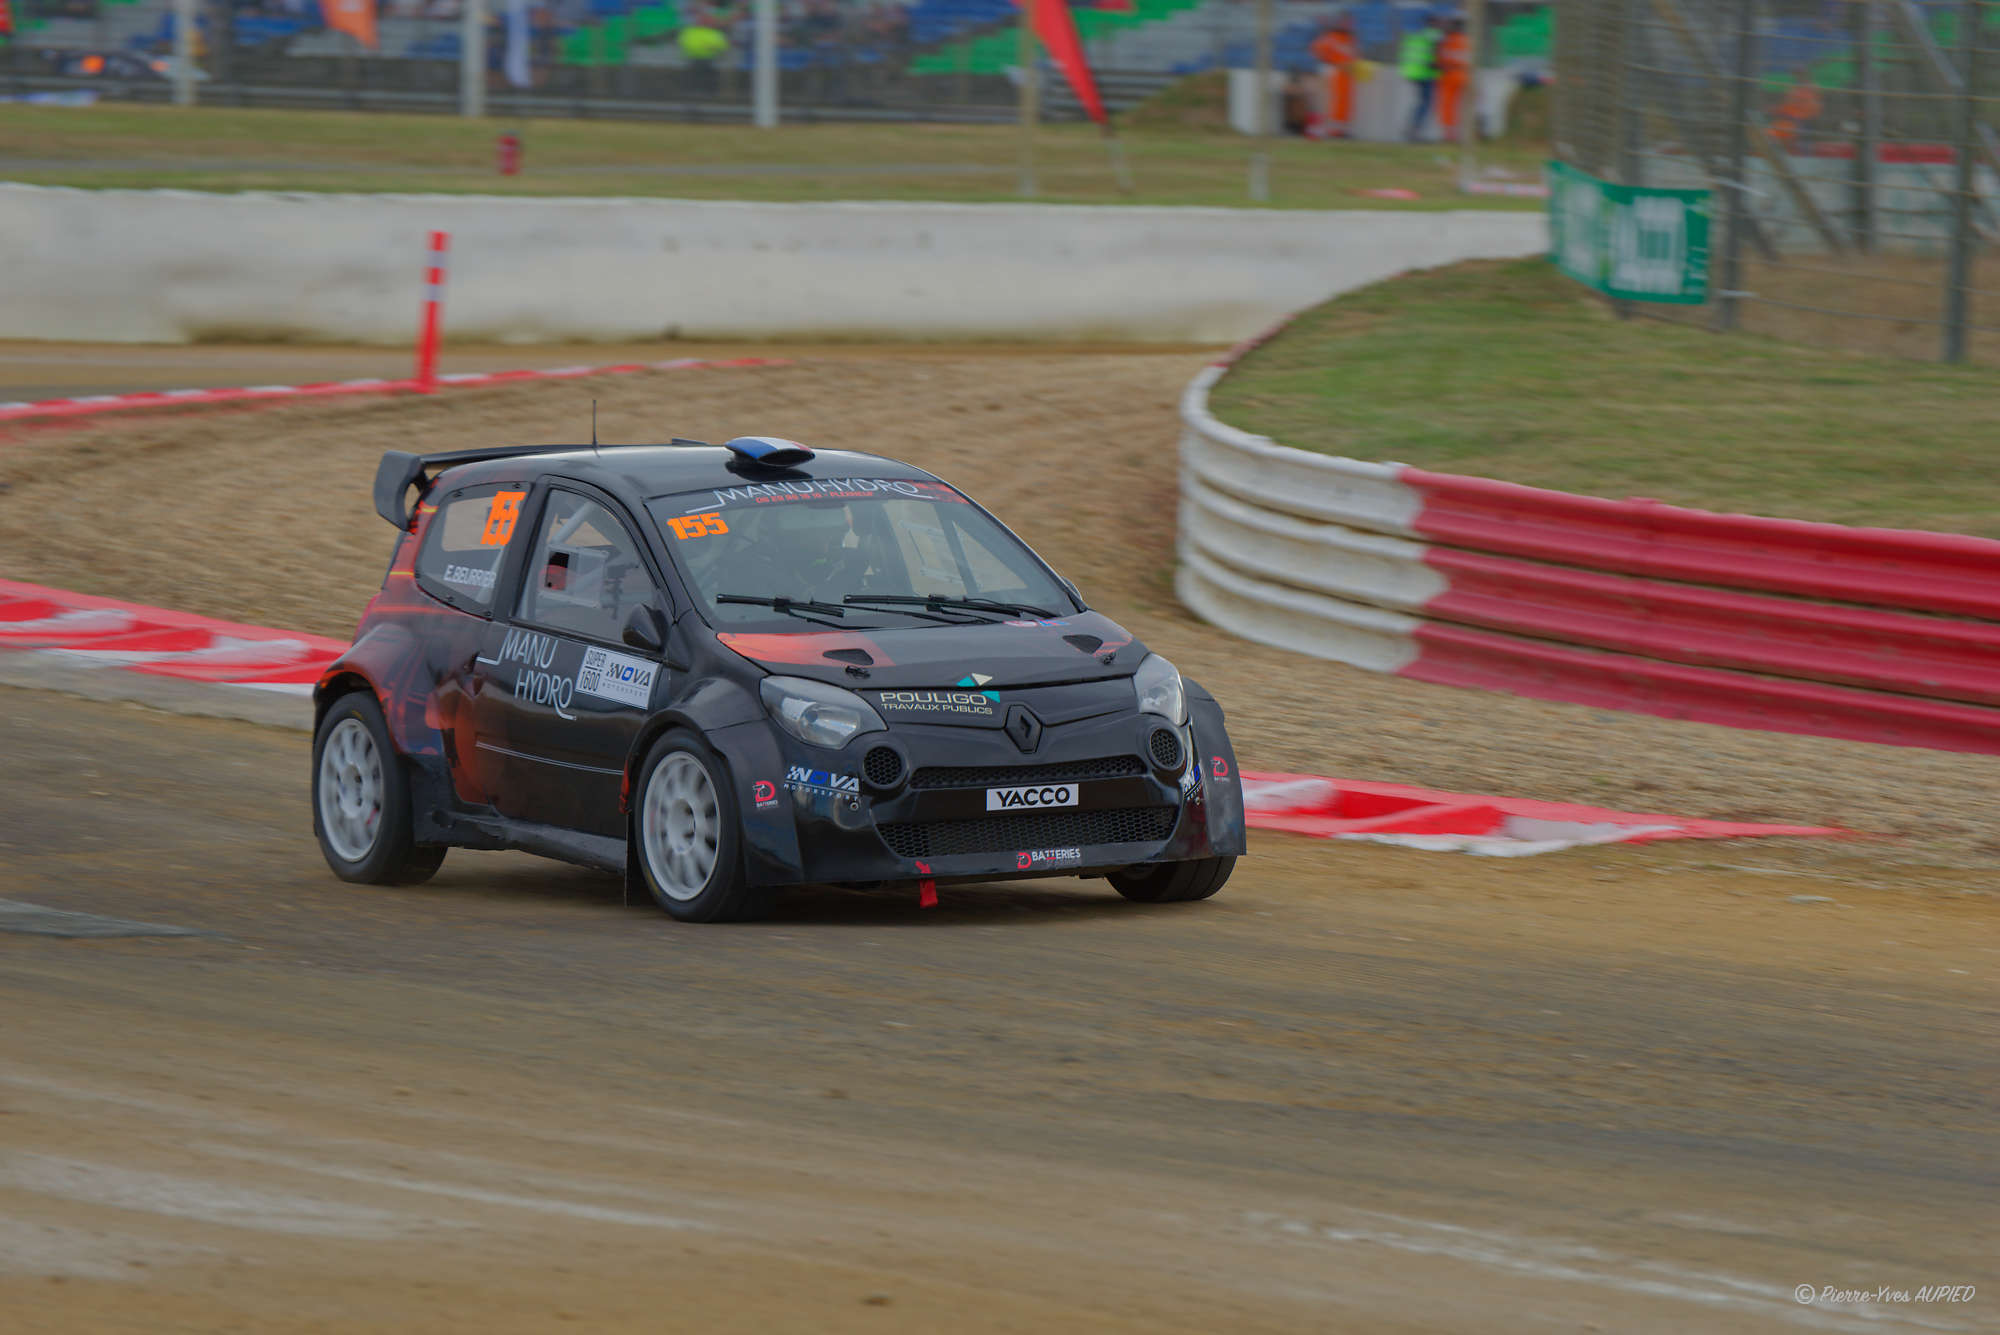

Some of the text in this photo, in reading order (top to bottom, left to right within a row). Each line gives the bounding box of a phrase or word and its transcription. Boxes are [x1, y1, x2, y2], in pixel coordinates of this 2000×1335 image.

[480, 491, 527, 545] 155
[667, 512, 729, 540] 155
[476, 629, 558, 668] MANU
[586, 650, 607, 667] SUPER
[580, 670, 600, 692] 1600
[514, 669, 577, 720] HYDRO
[880, 692, 987, 705] POULIGO
[881, 703, 992, 715] TRAVAUX PUBLICS
[784, 782, 858, 801] MOTORSPORT
[996, 787, 1070, 807] YACCO
[1031, 848, 1081, 861] BATTERIES
